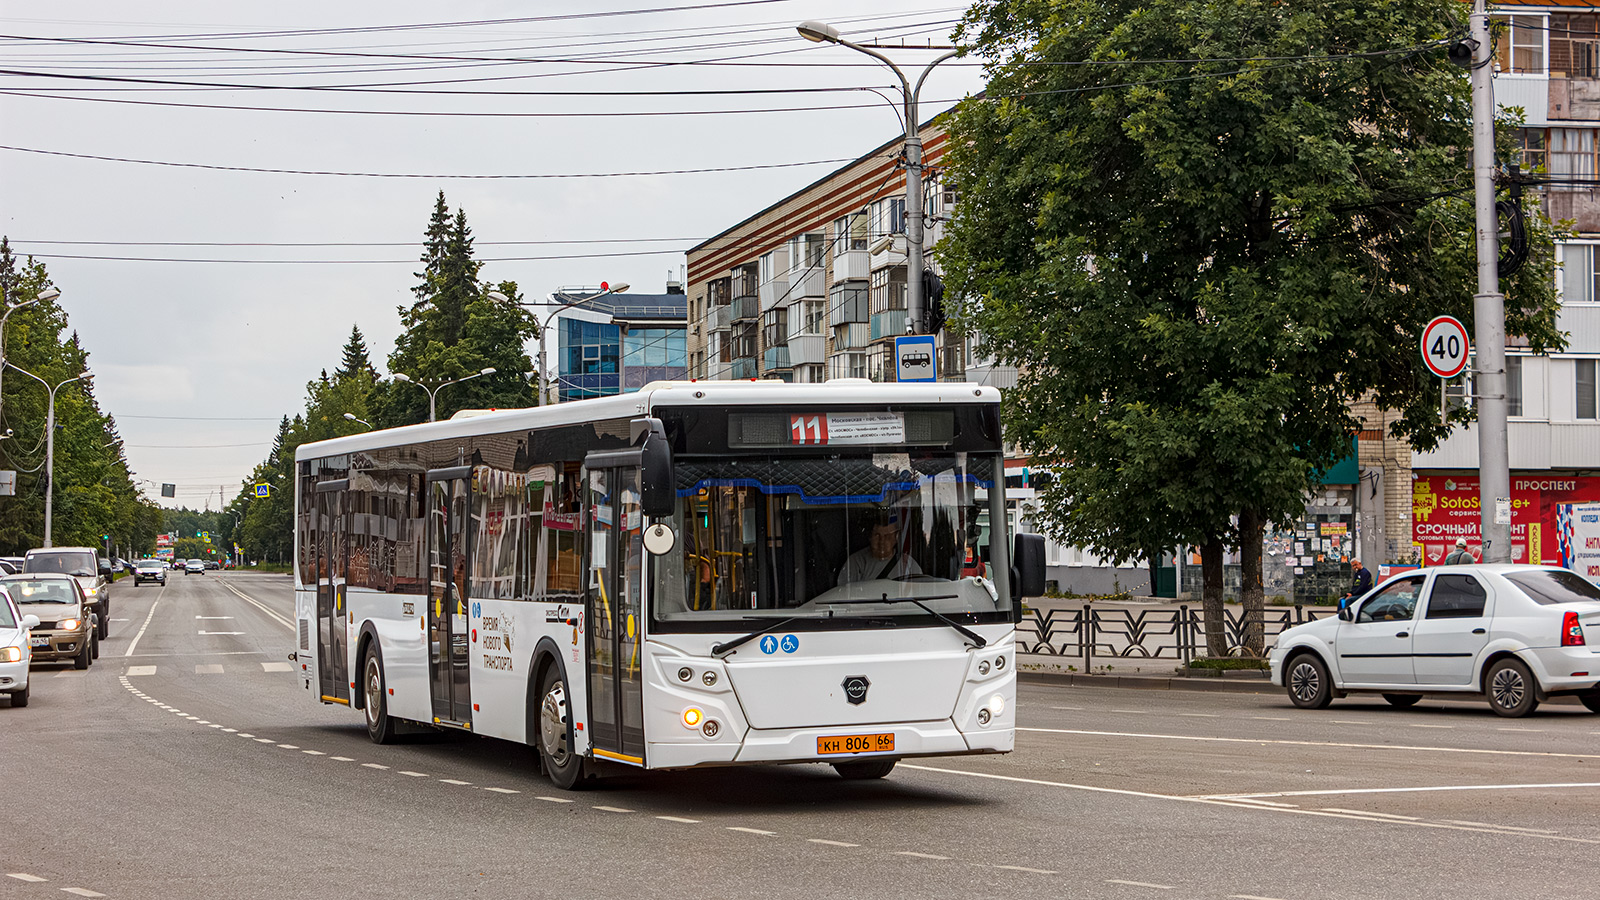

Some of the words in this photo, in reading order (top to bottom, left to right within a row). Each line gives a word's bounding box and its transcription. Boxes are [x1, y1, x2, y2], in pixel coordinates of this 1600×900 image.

[1431, 335, 1460, 359] 40
[792, 416, 821, 444] 11
[1515, 480, 1576, 490] ПРОСПЕКТ
[1416, 522, 1476, 534] СРОЧНЫЙ
[482, 616, 498, 631] ВРЕМЯ
[482, 635, 501, 651] НОВОГО
[483, 654, 513, 671] ТРАНСПОРТА
[824, 741, 840, 751] КН
[845, 737, 870, 750] 806
[877, 735, 890, 745] 66
